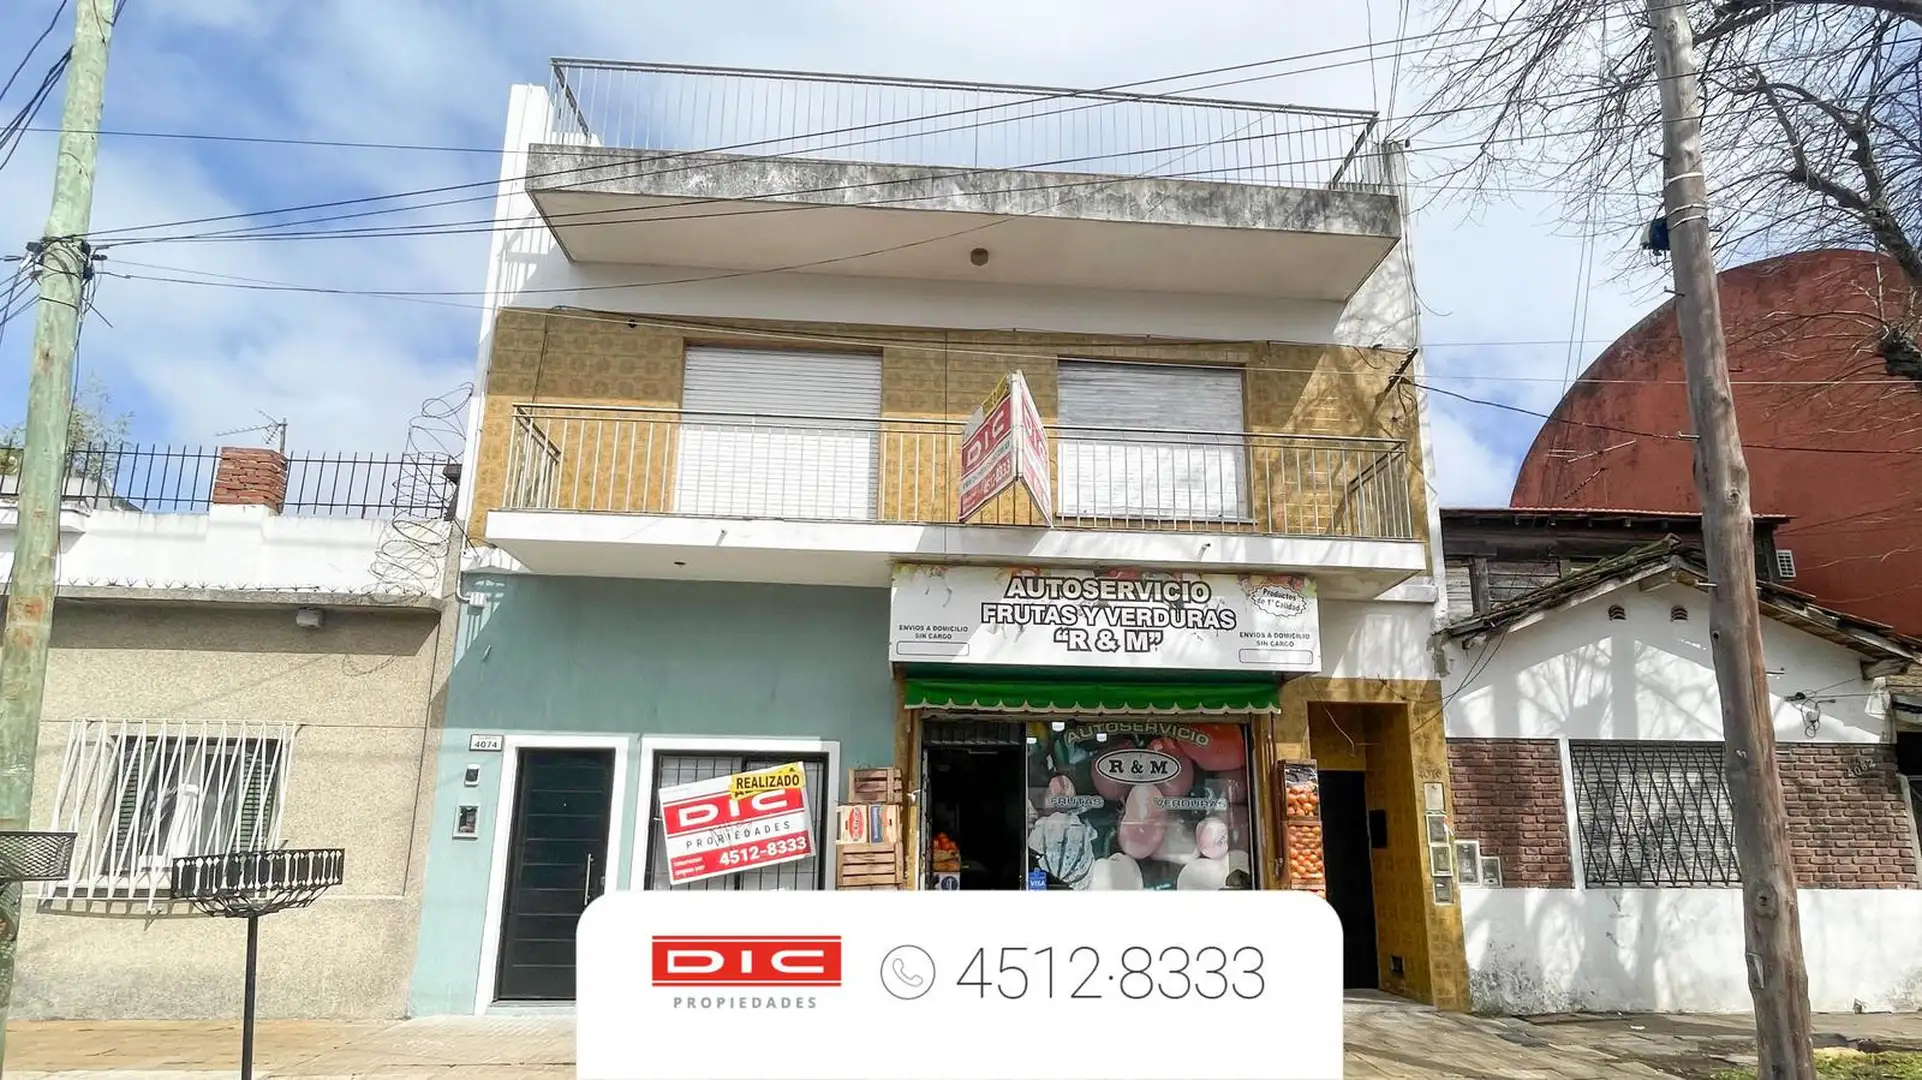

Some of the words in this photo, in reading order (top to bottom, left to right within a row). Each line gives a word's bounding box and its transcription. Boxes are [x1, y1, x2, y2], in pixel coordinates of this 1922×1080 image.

[966, 410, 1005, 468] DIC
[1004, 576, 1212, 604] AUTOSERVICIO
[1263, 588, 1297, 601] Productos
[981, 602, 1078, 627] FRUTAS
[1083, 605, 1103, 627] Y
[1100, 605, 1237, 630] VERDURAS
[1275, 600, 1301, 612] Calidad
[1095, 629, 1120, 652] &
[474, 740, 498, 748] 4074
[1066, 721, 1210, 747] AUTOSERVICIO
[1109, 759, 1124, 774] R
[1130, 760, 1143, 774] &
[1150, 760, 1169, 775] M
[735, 774, 800, 790] REALIZADO
[678, 788, 788, 828] DIC
[1050, 795, 1103, 807] FRUTAS
[1154, 796, 1228, 810] VERDURAS
[686, 821, 790, 849] PROPIEDADES
[719, 836, 807, 866] 4512-8333
